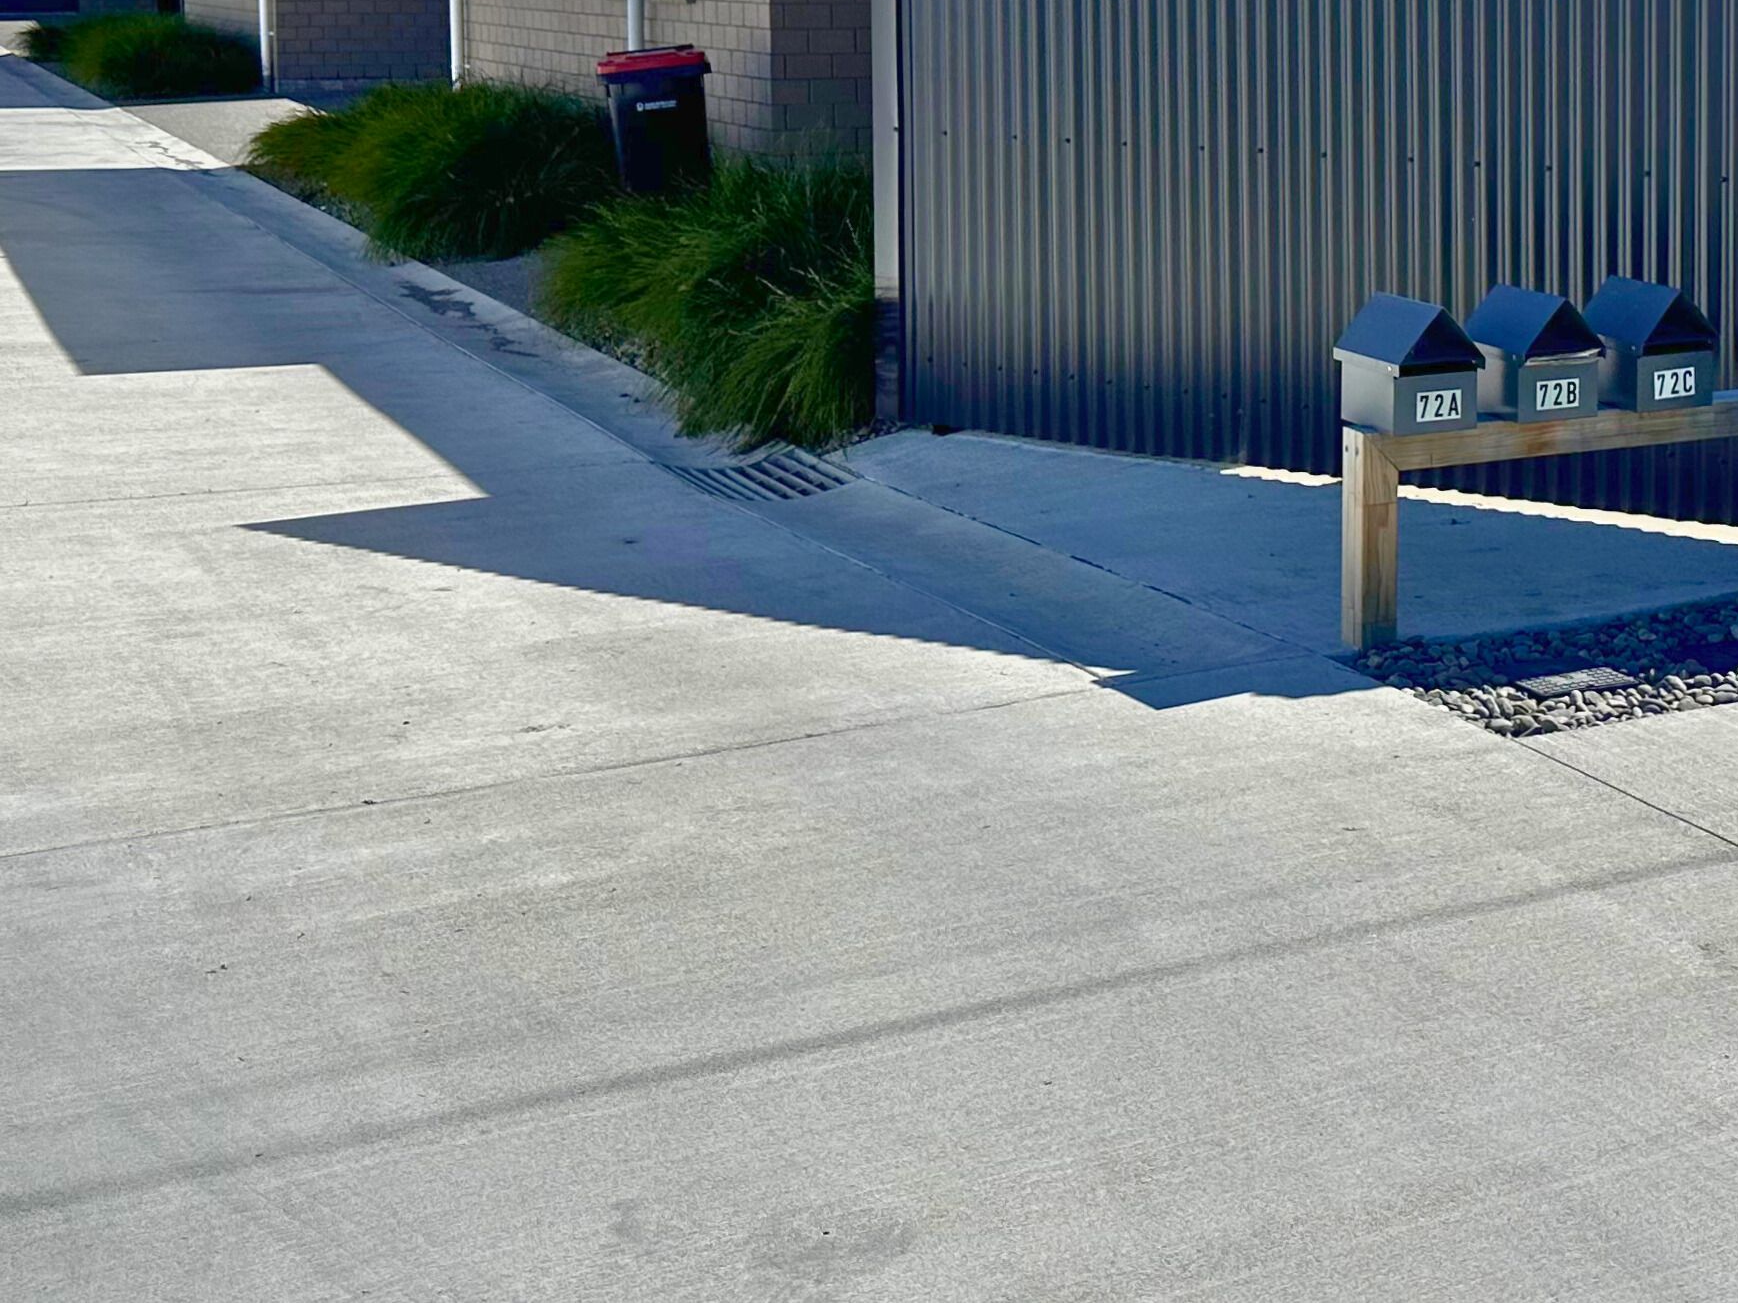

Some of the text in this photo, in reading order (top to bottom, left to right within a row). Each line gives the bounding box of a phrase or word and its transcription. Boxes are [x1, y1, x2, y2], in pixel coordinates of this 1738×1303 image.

[1539, 381, 1577, 407] 72B
[1657, 370, 1692, 396] 72C
[1420, 392, 1459, 418] 72A
